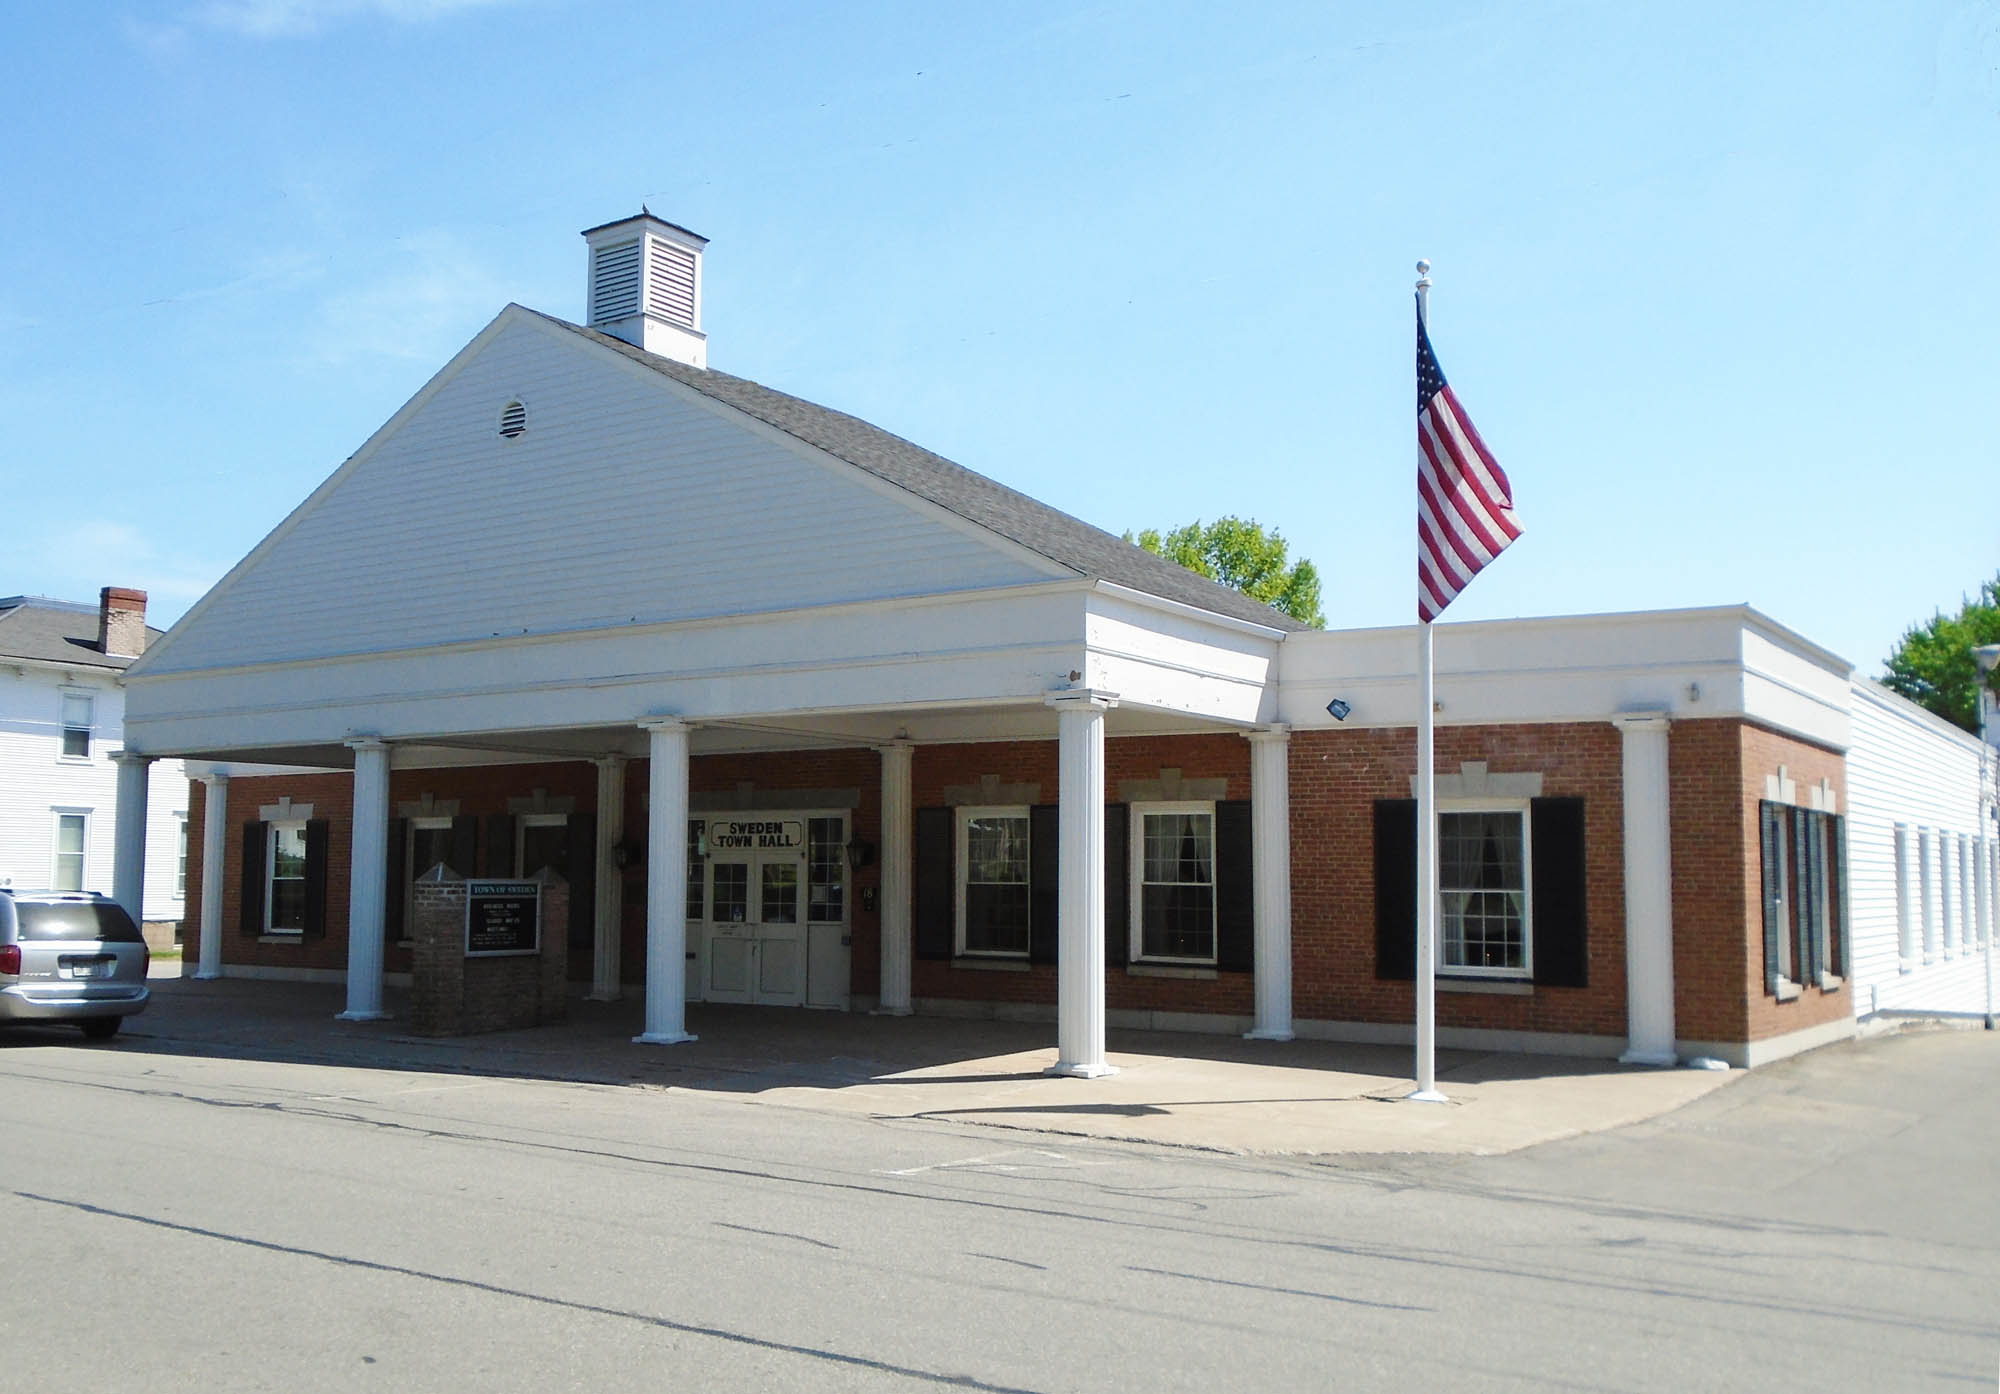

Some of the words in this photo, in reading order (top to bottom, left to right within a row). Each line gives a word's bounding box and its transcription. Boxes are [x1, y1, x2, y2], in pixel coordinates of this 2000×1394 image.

[729, 822, 783, 834] SWEDEN
[718, 835, 752, 848] TOWN
[759, 835, 794, 848] HALL
[474, 886, 495, 894] TOWN
